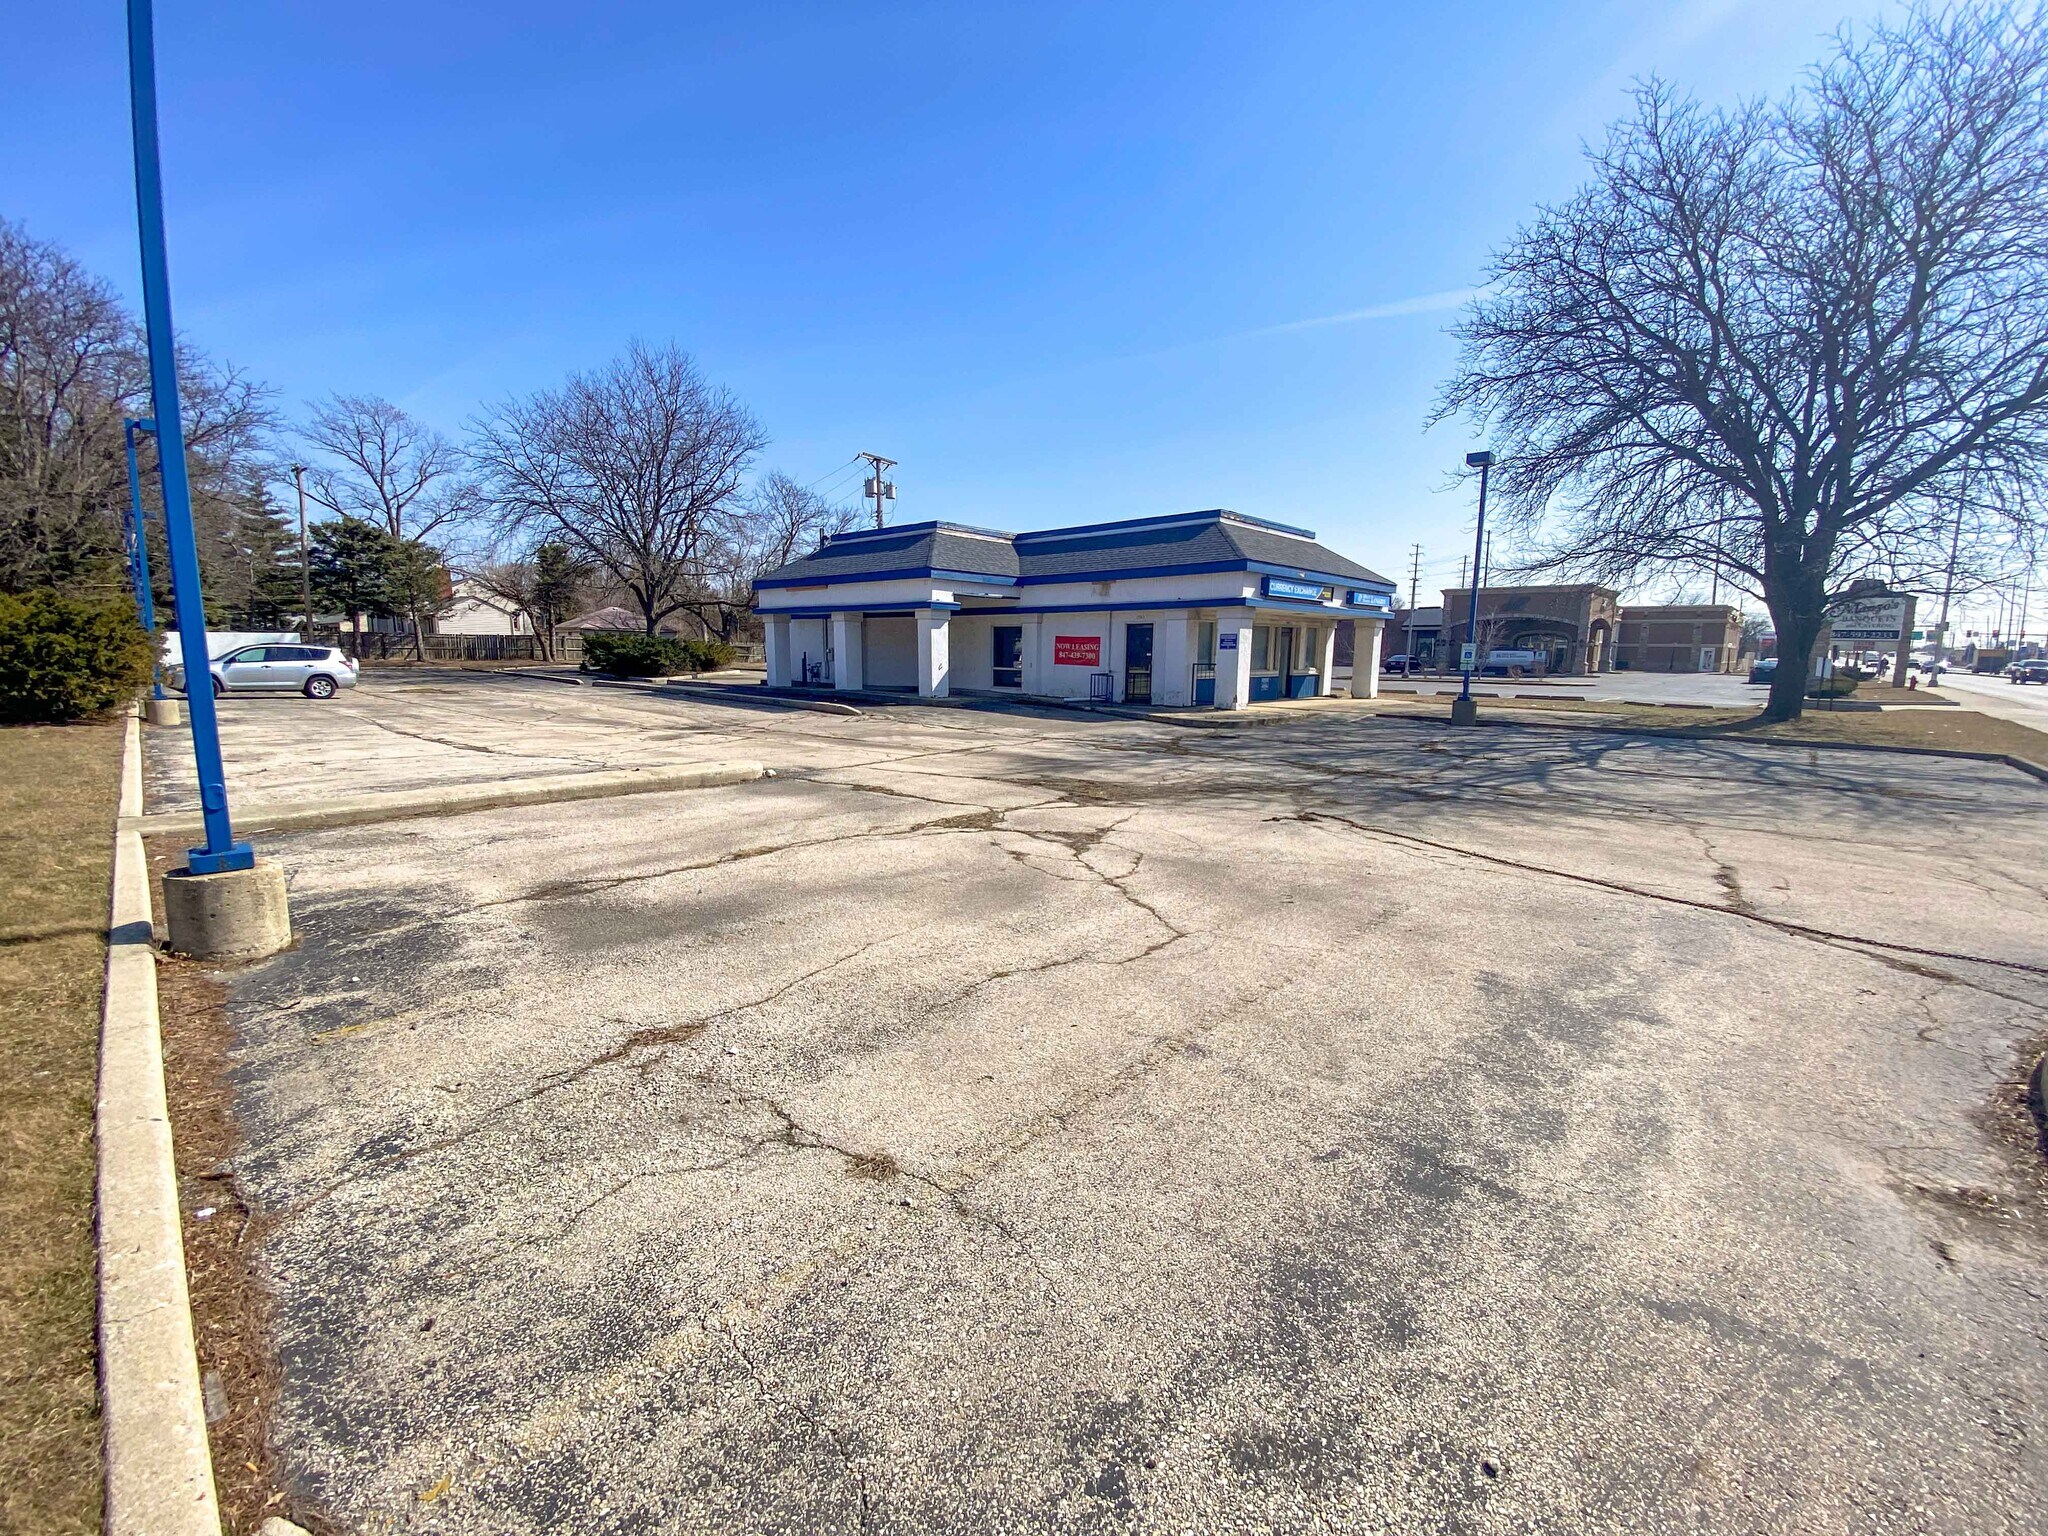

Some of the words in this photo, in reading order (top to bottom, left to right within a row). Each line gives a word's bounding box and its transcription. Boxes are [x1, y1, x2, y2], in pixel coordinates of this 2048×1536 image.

[1270, 582, 1295, 593] CURRENCY
[1294, 586, 1318, 597] EXCHANGE
[1071, 643, 1099, 651] LEASING
